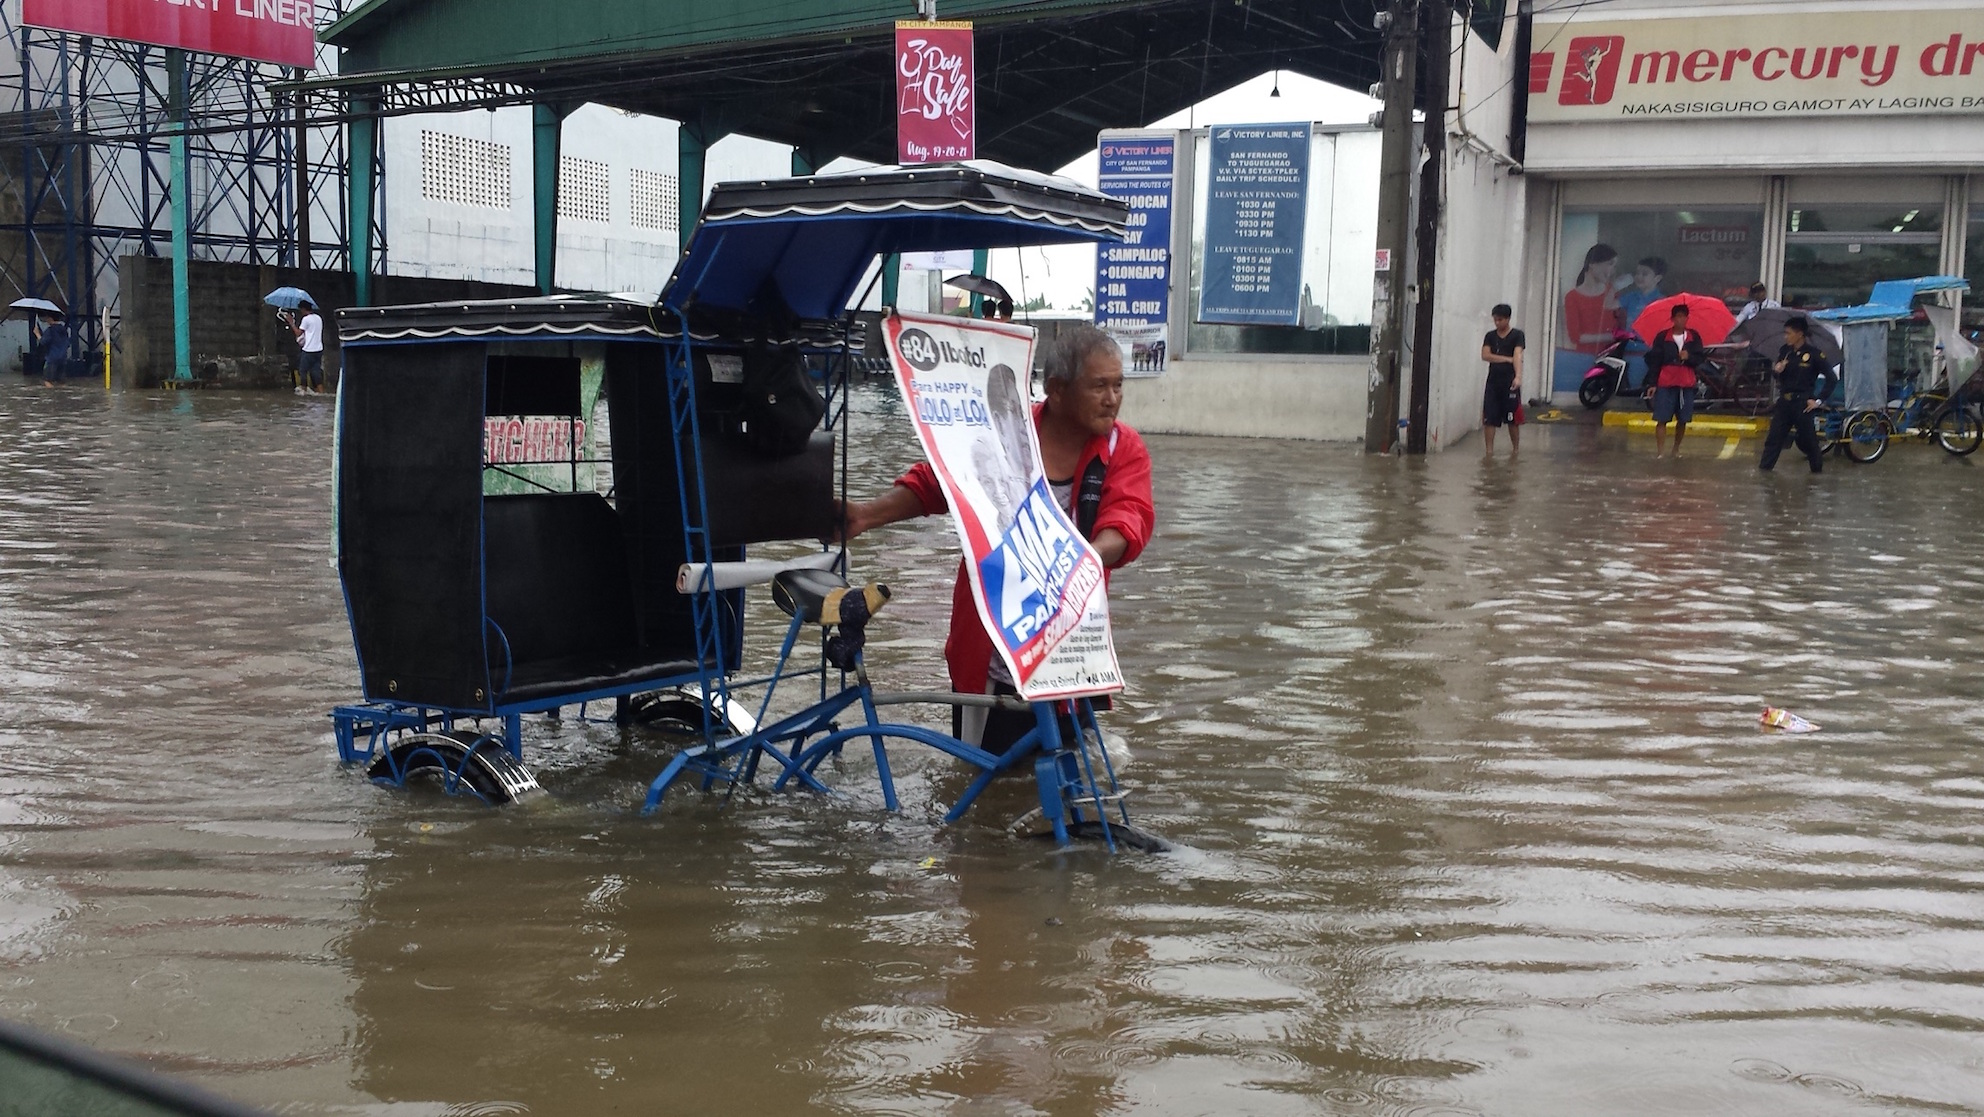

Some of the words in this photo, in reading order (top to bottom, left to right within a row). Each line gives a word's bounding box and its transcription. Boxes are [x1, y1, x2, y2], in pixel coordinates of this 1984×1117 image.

[236, 0, 313, 29] LINER
[900, 39, 928, 77] 3
[923, 46, 962, 83] Day
[1628, 45, 1900, 87] mercury
[1919, 33, 1984, 77] dr
[922, 72, 970, 120] Sale
[1622, 101, 1768, 115] NAKASISIGURO
[1773, 100, 1846, 112] GAMOT
[1849, 99, 1875, 109] AY
[1878, 97, 1955, 109] LAGING
[1234, 131, 1265, 139] VICTORY
[1267, 131, 1290, 139] LINER,
[1292, 131, 1305, 139] INC.
[908, 141, 930, 161] Aug.
[1115, 147, 1149, 155] VICTORY
[1151, 147, 1173, 155] LINER
[1112, 196, 1168, 209] OOCAN
[1262, 211, 1275, 219] PM
[1261, 220, 1274, 228] PM
[1260, 230, 1274, 238] PM
[1681, 229, 1746, 243] Lactum
[1108, 248, 1167, 262] SAMPALOC
[1258, 256, 1272, 264] AM
[1108, 266, 1165, 280] OLONGAPO
[1258, 266, 1271, 274] PM
[1257, 275, 1271, 283] PM
[1108, 283, 1127, 297] IBA
[1256, 285, 1270, 293] PM
[1107, 301, 1130, 314] STA.
[1132, 301, 1161, 315] CRUZ
[901, 335, 936, 363] #84
[940, 341, 987, 369] Iboto!
[934, 382, 968, 394] HAPPY
[916, 396, 952, 423] LOLO
[1002, 490, 1071, 629] AMA
